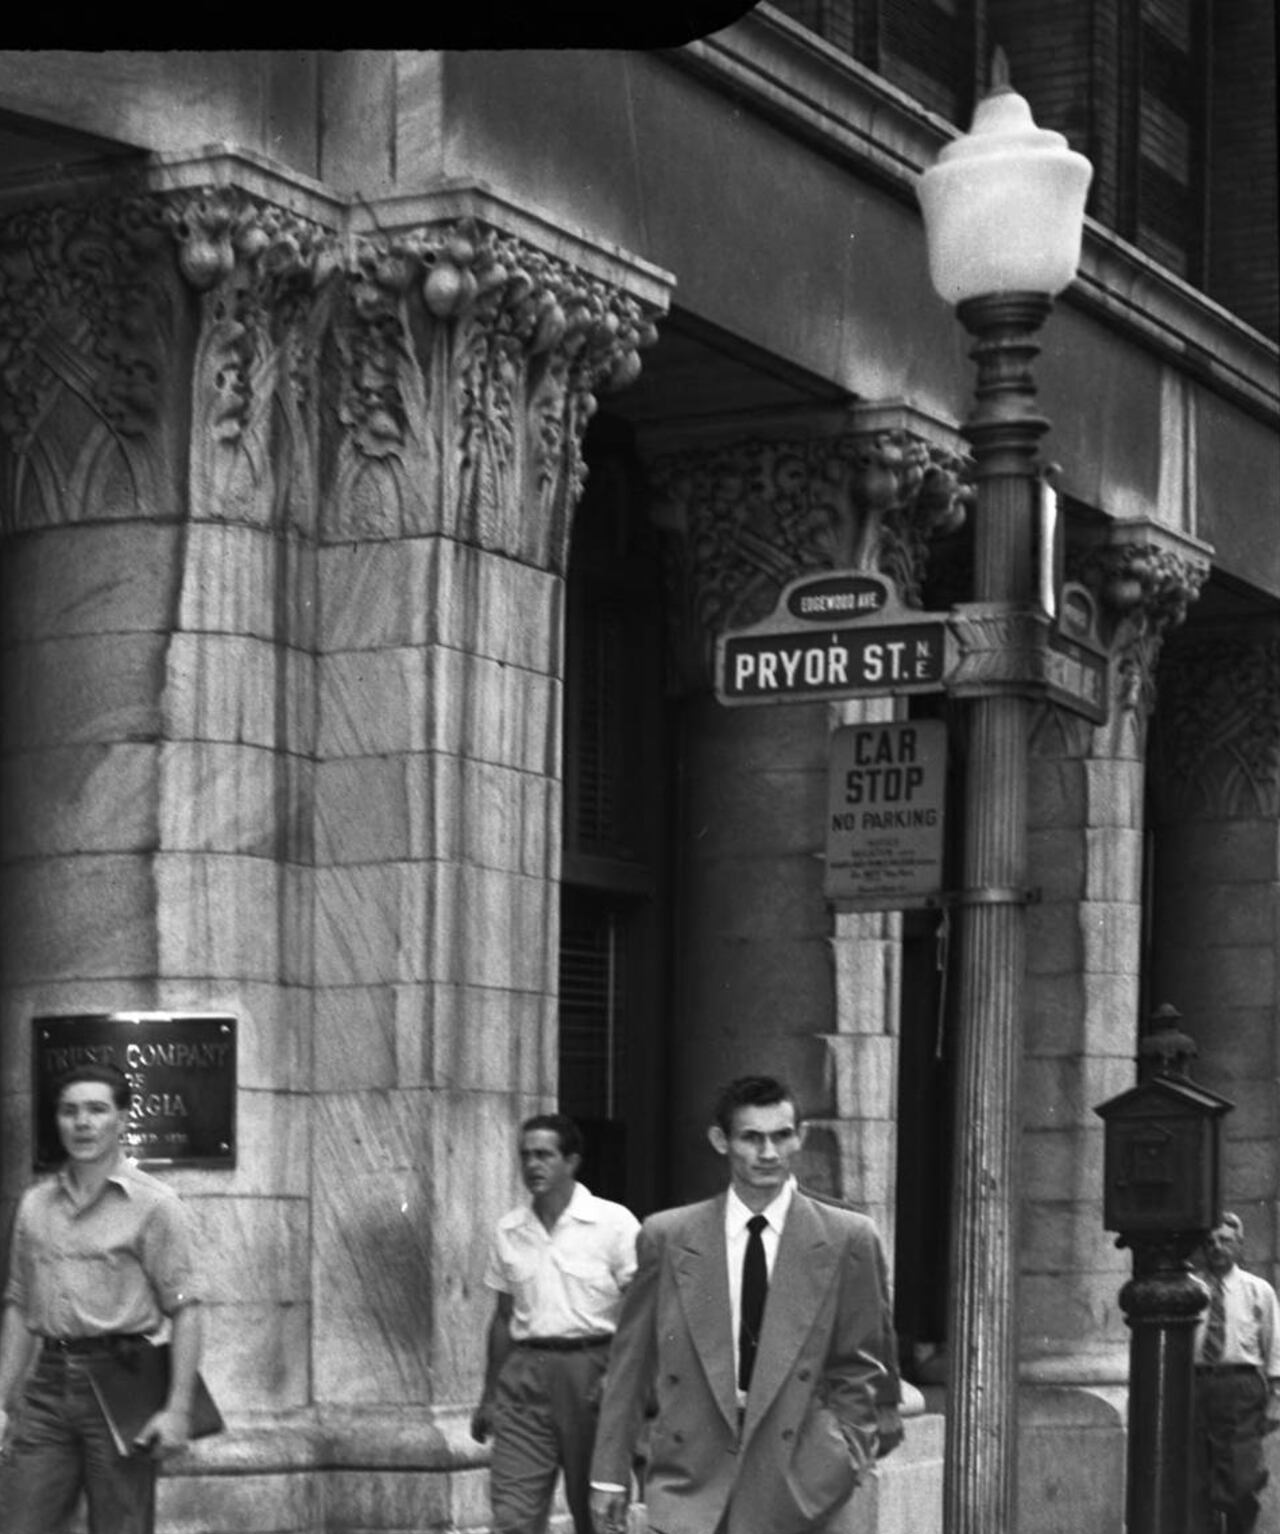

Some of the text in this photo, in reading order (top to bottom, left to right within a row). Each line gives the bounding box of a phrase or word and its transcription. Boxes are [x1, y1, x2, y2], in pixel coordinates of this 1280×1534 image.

[735, 648, 848, 690] PRYOR
[863, 643, 910, 680] ST.
[855, 729, 917, 766] CAR
[846, 767, 924, 803] STOP
[831, 807, 938, 831] NO PARKING
[126, 1043, 228, 1068] COMPANY
[128, 1094, 188, 1119] RGIA
